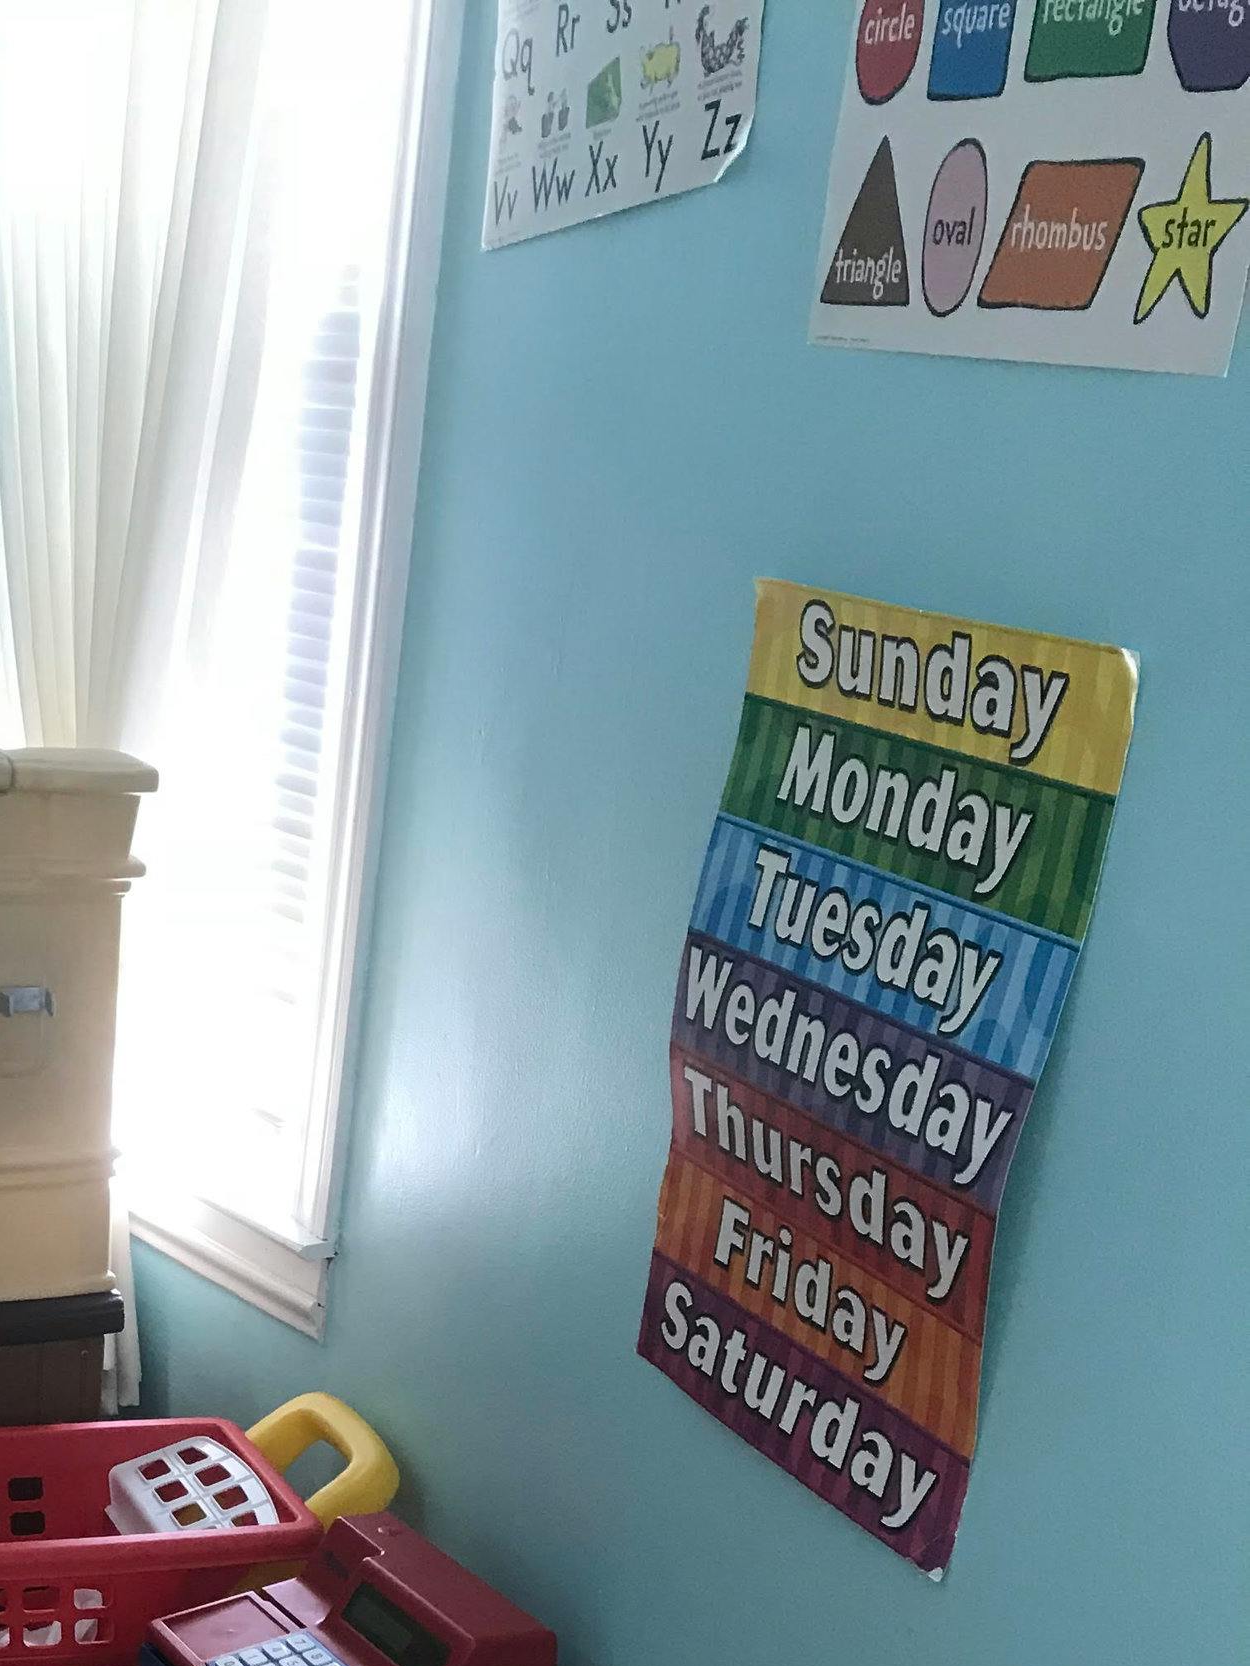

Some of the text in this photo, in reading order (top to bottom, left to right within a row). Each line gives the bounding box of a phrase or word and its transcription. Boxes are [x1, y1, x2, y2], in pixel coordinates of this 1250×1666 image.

[502, 28, 535, 95] Qq
[556, 3, 580, 57] Rr
[864, 10, 915, 45] circle
[941, 3, 1011, 49] square
[493, 176, 518, 225] Vv
[532, 157, 575, 213] Ww
[585, 140, 618, 197] Xx
[642, 120, 673, 193] Yy
[701, 99, 742, 160] Zz
[835, 206, 1217, 299] triangle oval rhombus star
[797, 600, 1069, 766] Sunday
[776, 723, 1035, 896] Monday
[748, 845, 1003, 1035] Tuesday
[686, 945, 1013, 1185] Wednesday
[683, 1066, 970, 1299] Thursday
[713, 1197, 908, 1383] Friday
[659, 1281, 938, 1529] Saturday
